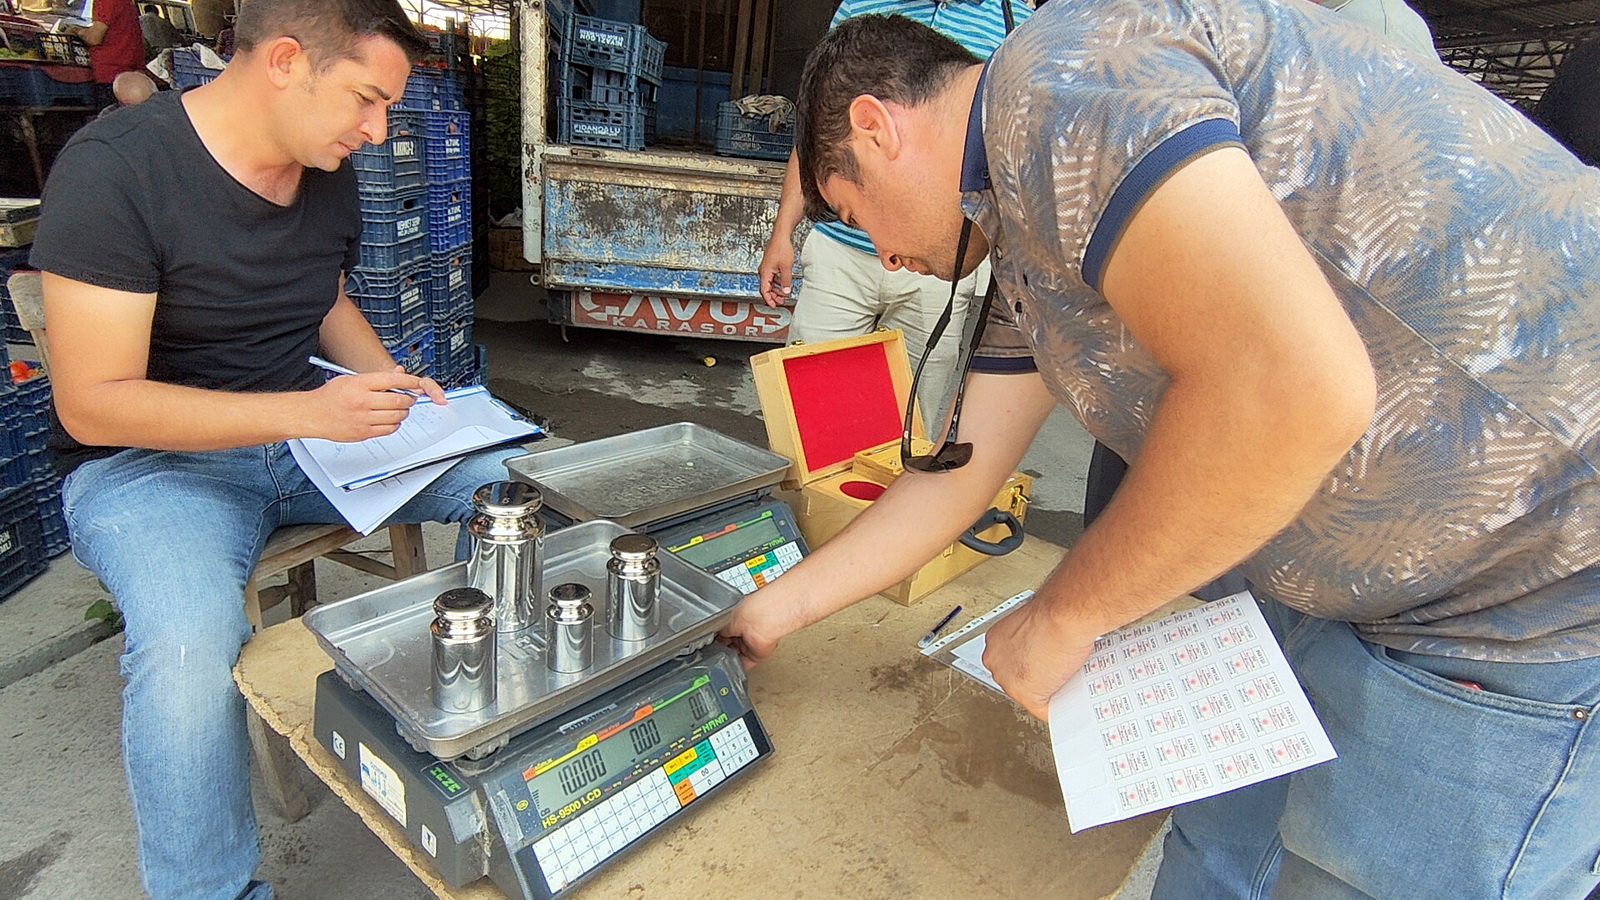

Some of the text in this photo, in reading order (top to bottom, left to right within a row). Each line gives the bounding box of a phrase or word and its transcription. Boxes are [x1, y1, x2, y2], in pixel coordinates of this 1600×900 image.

[702, 713, 728, 734] HANA
[542, 788, 602, 828] HS-9500 LCD
